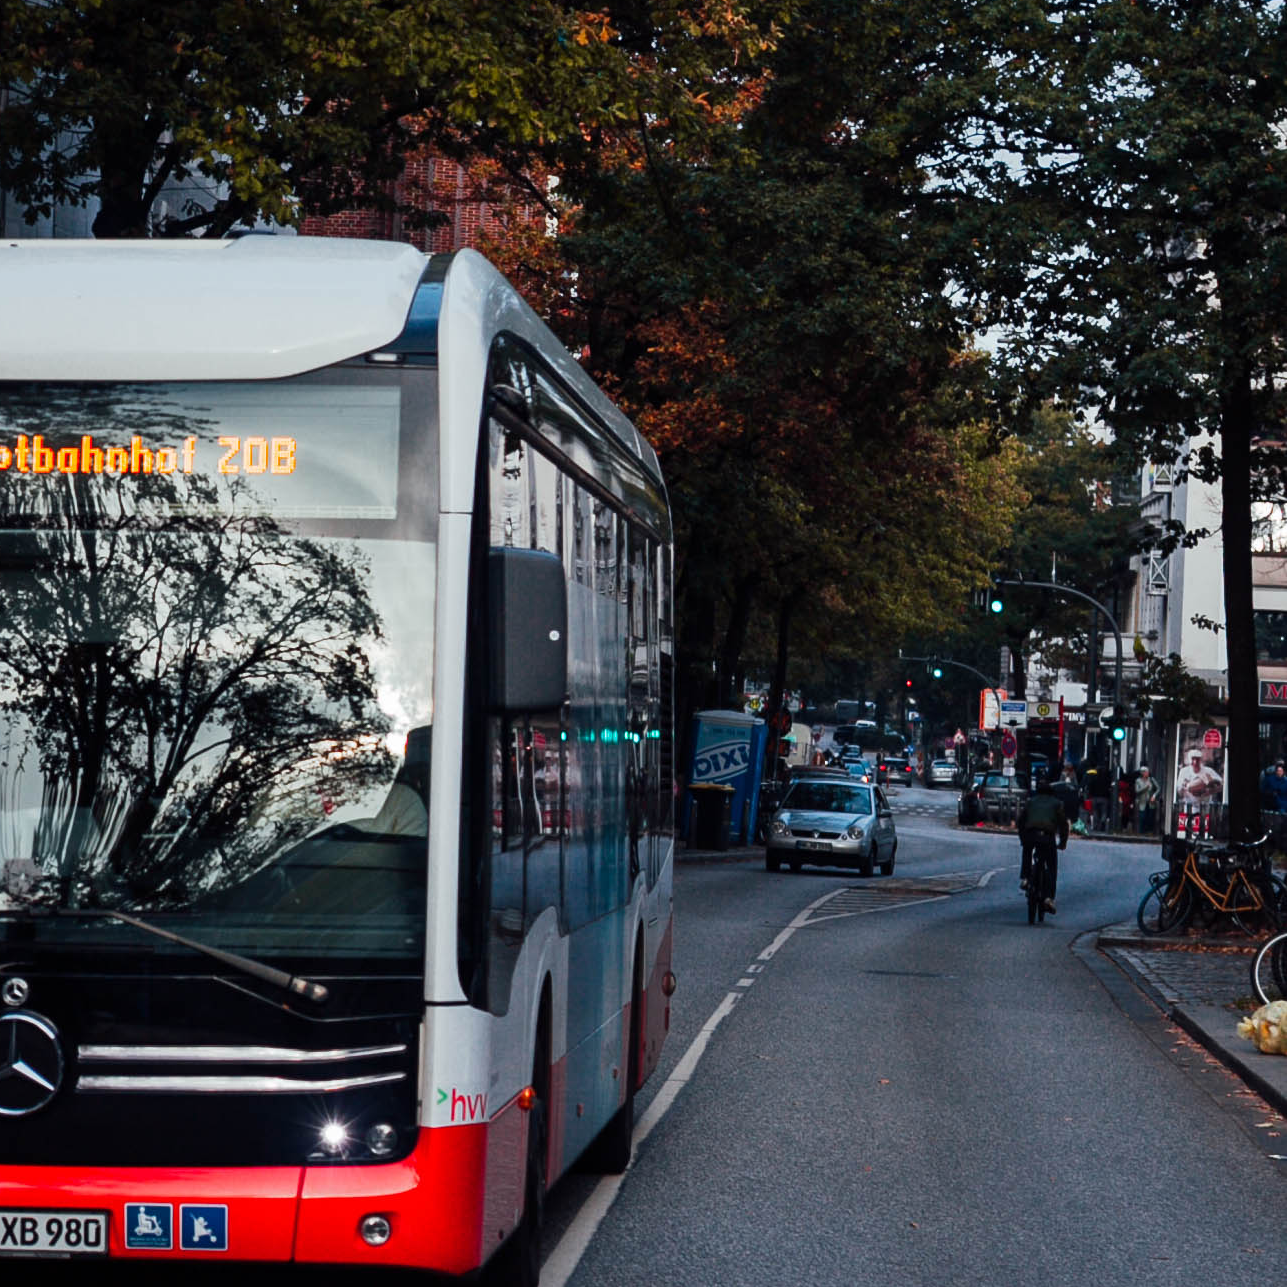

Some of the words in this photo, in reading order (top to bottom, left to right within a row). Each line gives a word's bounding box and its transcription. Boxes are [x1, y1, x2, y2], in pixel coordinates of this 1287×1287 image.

[217, 435, 297, 475] ZOB
[696, 745, 749, 778] DIXI
[451, 1088, 488, 1122] hvv
[0, 1217, 39, 1246] XB
[45, 1218, 102, 1247] 980
